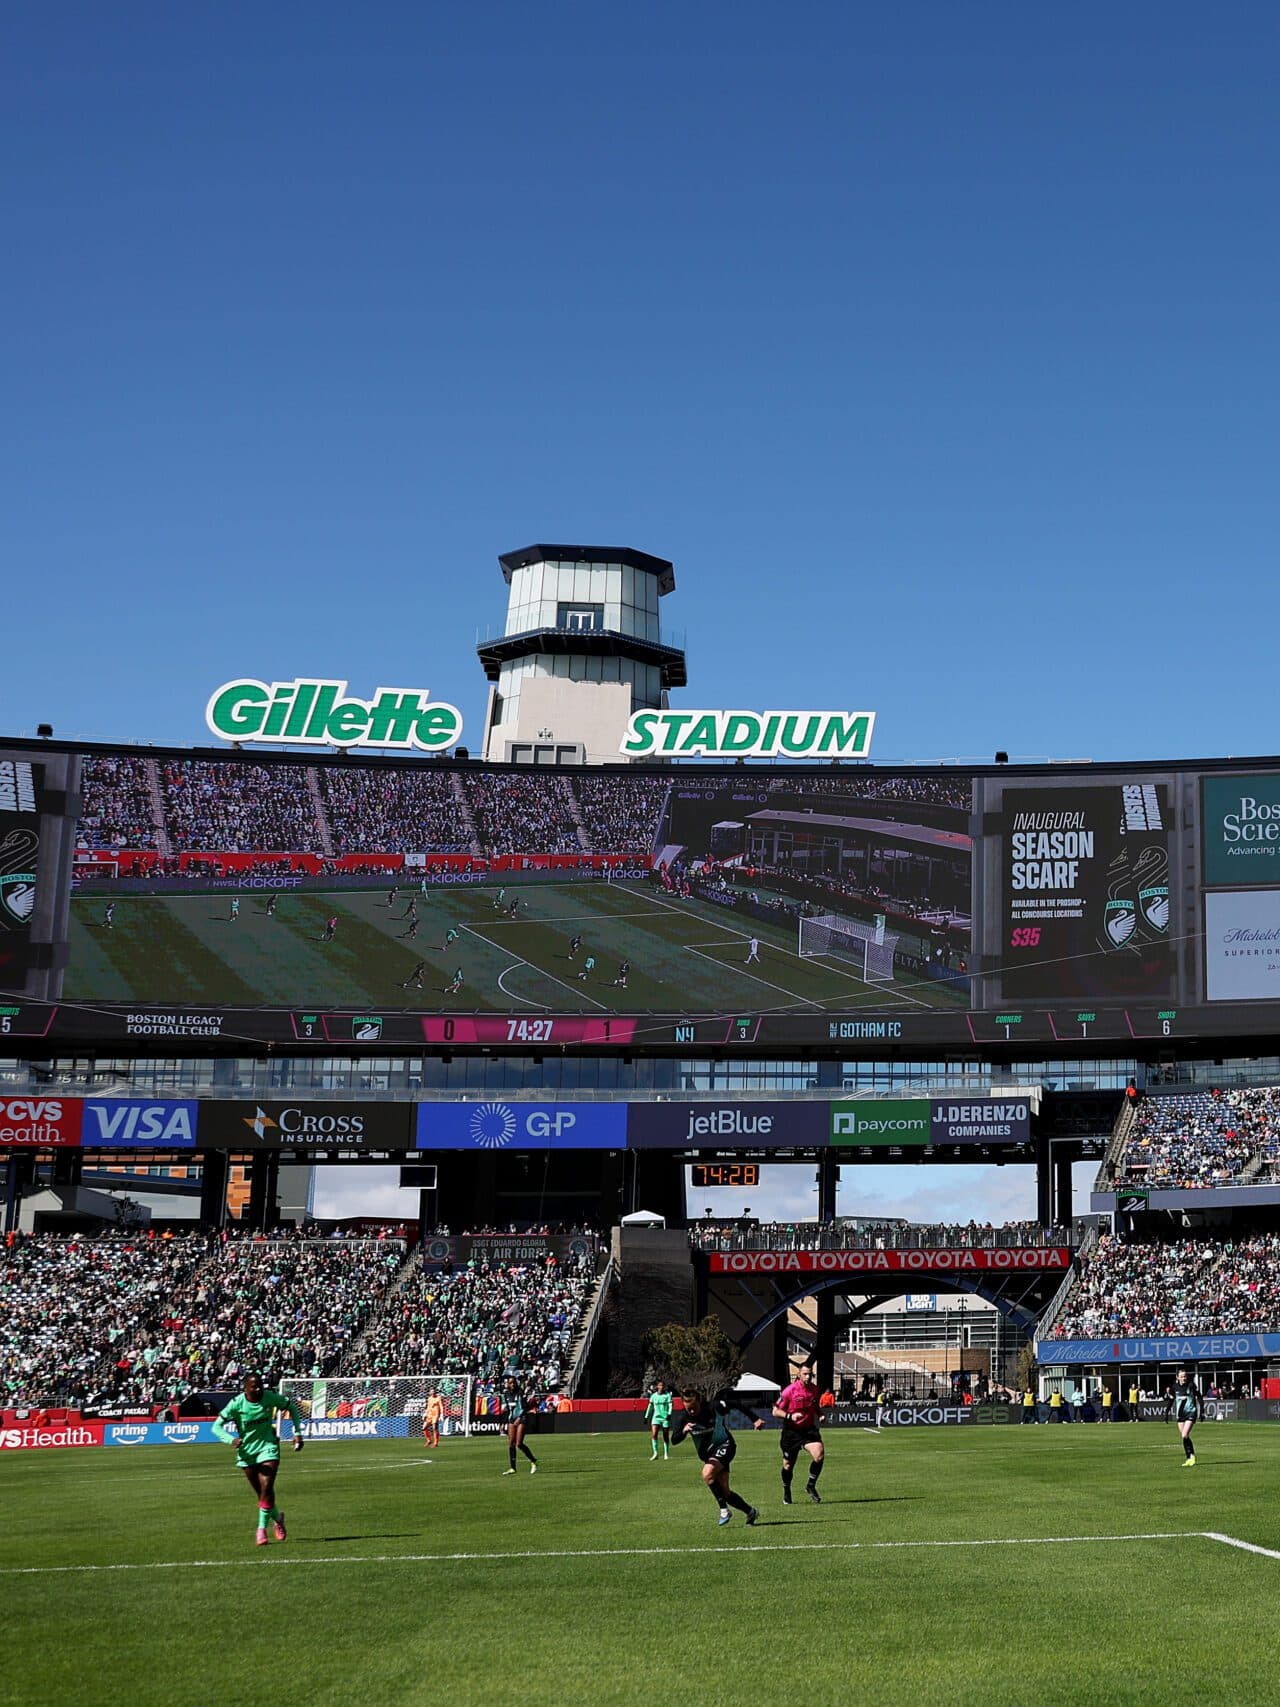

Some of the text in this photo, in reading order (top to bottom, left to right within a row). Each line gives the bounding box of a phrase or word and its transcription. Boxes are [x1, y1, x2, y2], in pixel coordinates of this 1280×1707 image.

[210, 682, 458, 747] Gillette
[624, 712, 870, 752] STADIUM
[1013, 811, 1085, 830] INAUGURAL
[1011, 831, 1094, 860] SEASON
[1227, 846, 1275, 856] Advancing
[238, 878, 302, 888] KICKOFF
[431, 872, 487, 883] KICKOFF
[1011, 861, 1079, 890] SCARF
[1011, 899, 1082, 908] AVAILABLE IN THE PROSHOP
[1011, 909, 1083, 919] ALL CONCOURSE LOCATIONS
[1011, 927, 1041, 947] $35
[1223, 927, 1280, 944] Michelob
[1225, 949, 1280, 957] SUPERIOR
[127, 1014, 224, 1026] BOSTON LEGACY
[995, 1015, 1022, 1024] CORNERS
[1077, 1013, 1096, 1022] SAVES
[1158, 1011, 1176, 1020] SHOTS
[1, 1016, 11, 1033] 5
[127, 1025, 221, 1035] FOOTBALL CLUB
[305, 1024, 312, 1036] 3
[443, 1019, 455, 1041] 0
[507, 1020, 553, 1041] 74:27
[603, 1020, 611, 1041] 1
[840, 1022, 902, 1038] GOTHAM FC
[1004, 1024, 1010, 1039] 1
[1081, 1022, 1087, 1038] 1
[1162, 1020, 1170, 1036] 6
[740, 1028, 747, 1039] 3
[7, 1101, 62, 1121] CVS
[932, 1104, 1027, 1124] J.DERENZO
[87, 1106, 192, 1140] VISA
[686, 1110, 773, 1140] jetBlue
[858, 1118, 924, 1134] paycom
[948, 1124, 1011, 1137] COMPANIES
[0, 1124, 60, 1143] ealth
[281, 1135, 364, 1143] INSURANCE
[697, 1165, 756, 1186] 74:28
[490, 1239, 522, 1248] EDUARDO
[522, 1239, 546, 1247] GLORIA
[493, 1247, 512, 1259] AIR
[809, 1251, 889, 1270] TOYOTA
[897, 1250, 977, 1268] TOYOTA
[984, 1248, 1062, 1267] TOYOTA
[720, 1252, 800, 1271] TOYOTA
[907, 1302, 934, 1311] LIGHT
[910, 1294, 932, 1303] BUD
[1041, 1341, 1108, 1362] Michelob
[1124, 1340, 1194, 1358] ULTRA
[1199, 1338, 1250, 1356] ZERO
[98, 1408, 122, 1416] COACH
[839, 1413, 875, 1423] NWSL
[878, 1407, 971, 1424] KICKOFF
[112, 1424, 148, 1438] prime
[164, 1423, 199, 1437] prime
